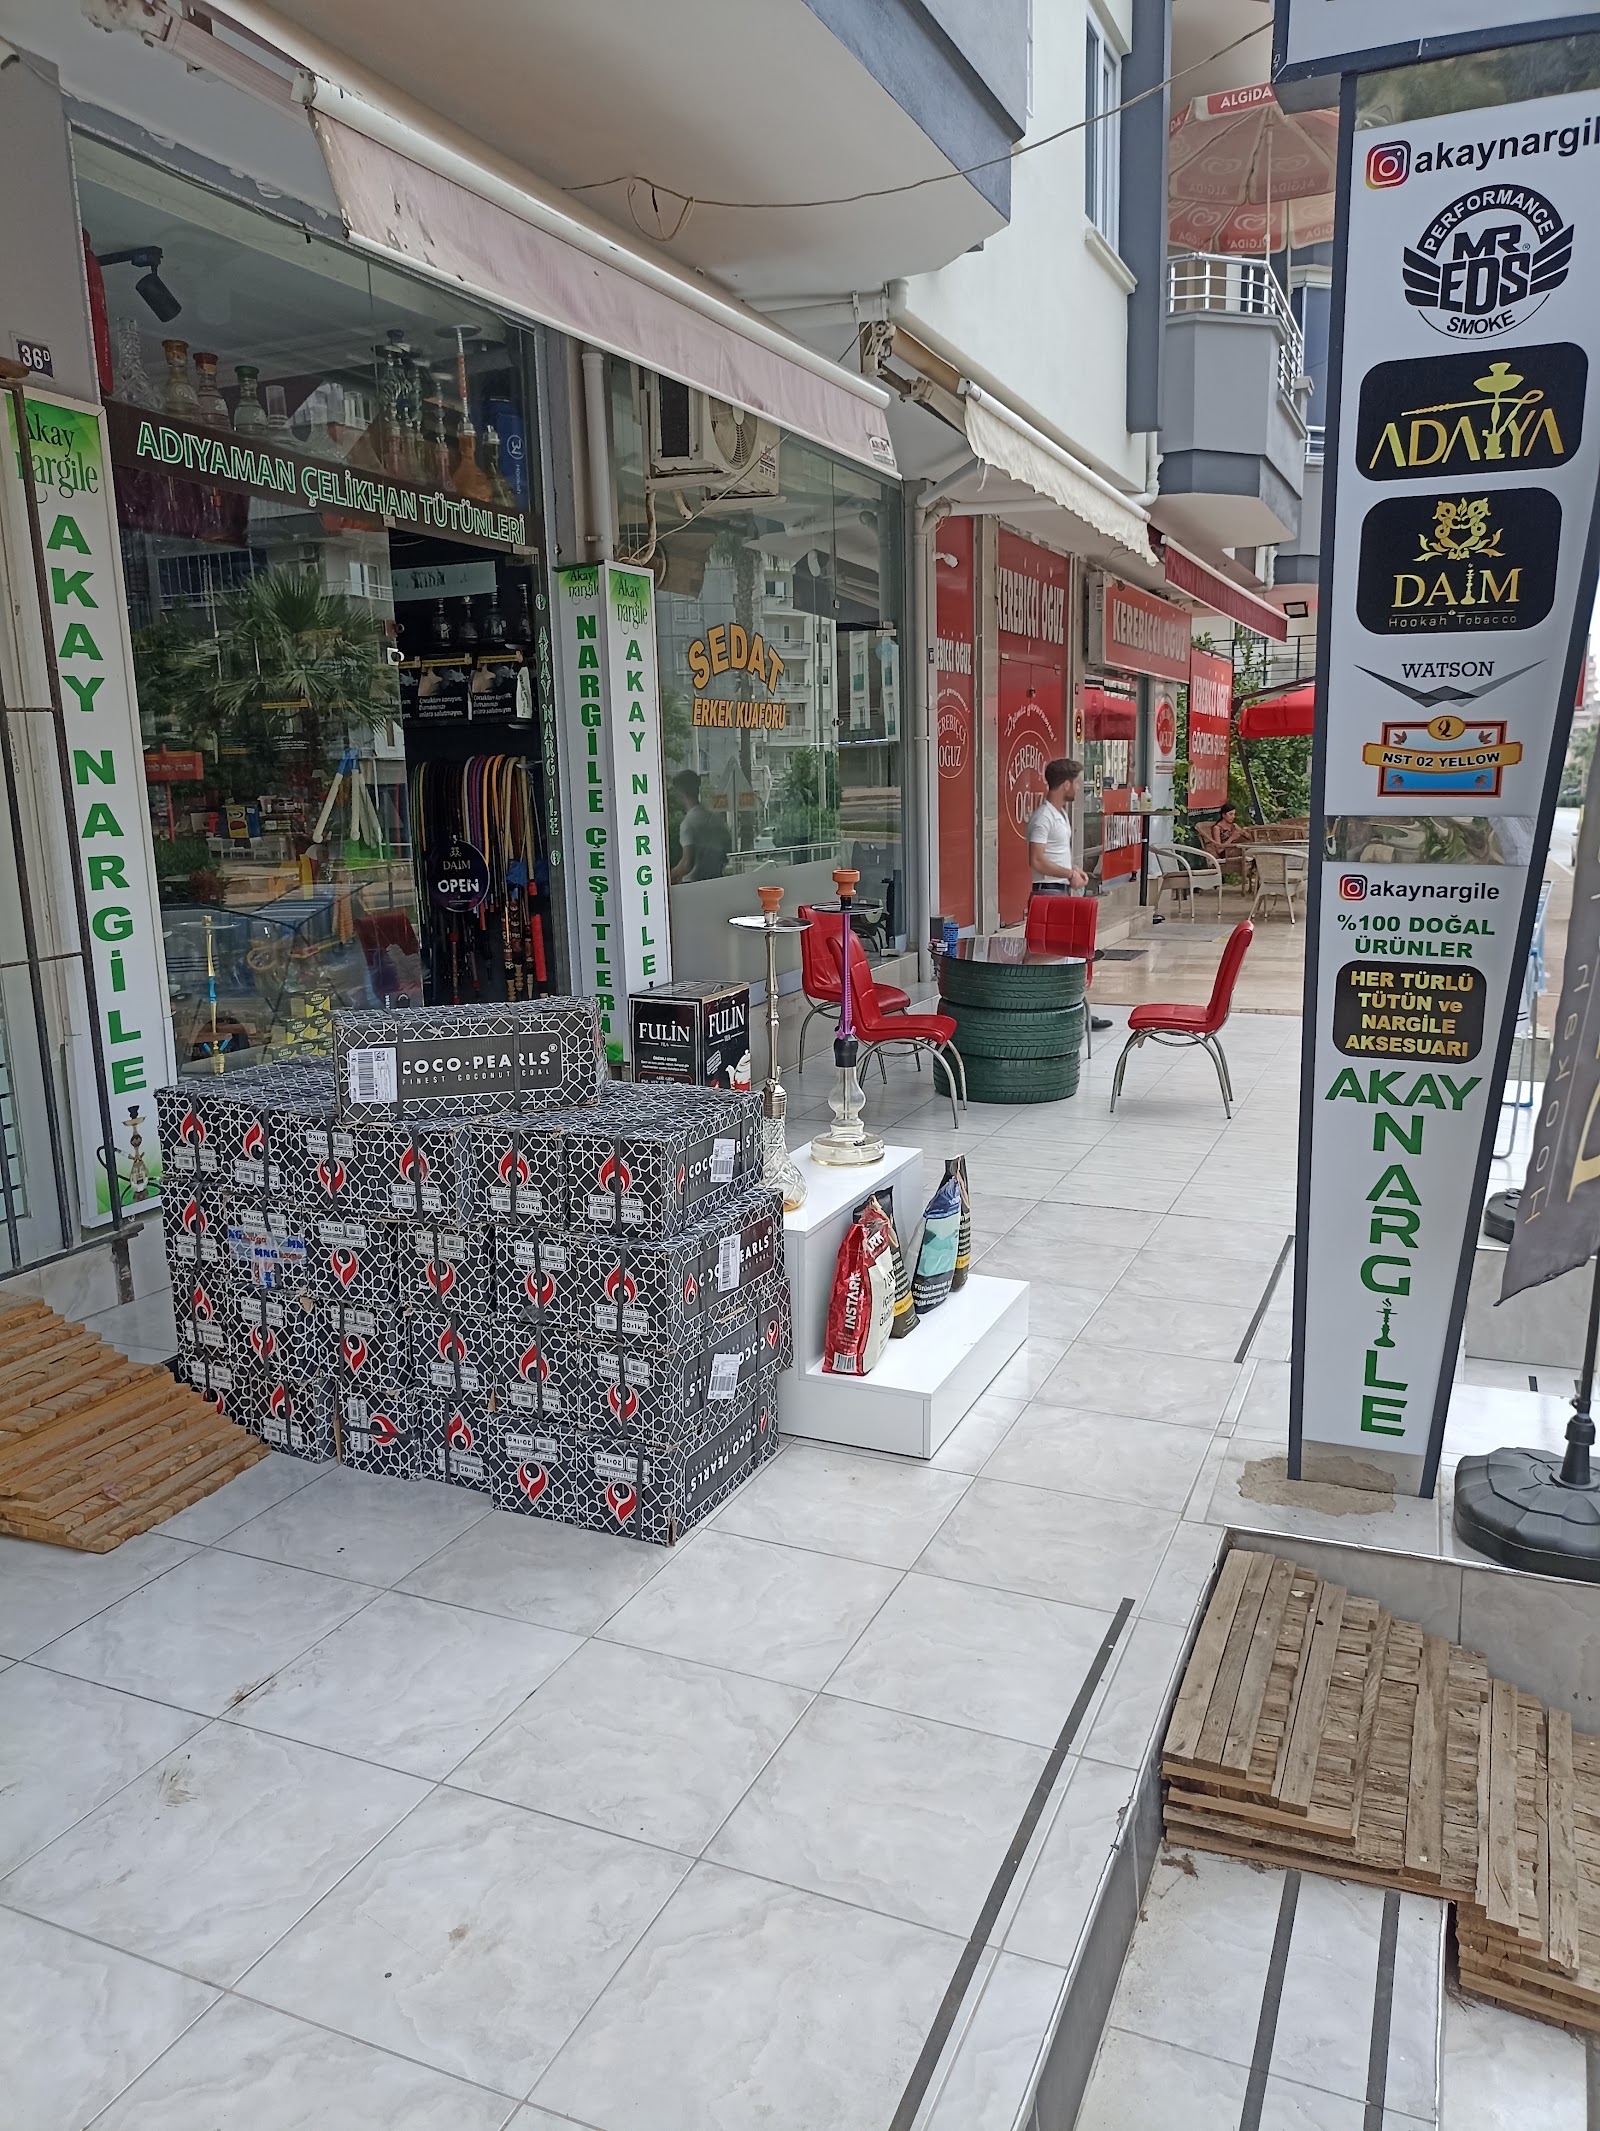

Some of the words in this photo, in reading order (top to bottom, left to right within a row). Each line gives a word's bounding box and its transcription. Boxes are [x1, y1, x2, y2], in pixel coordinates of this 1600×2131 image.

[1414, 116, 1600, 174] akaynargil
[1423, 189, 1555, 251] PERFORMANCE
[1440, 252, 1531, 315] EDS
[1446, 309, 1516, 335] SMOKE
[136, 421, 297, 494] ADIYAMAN
[302, 466, 417, 521] ÇELİKHAN
[419, 491, 527, 545] TÜTÜNLERİ
[570, 569, 594, 587] Akay
[618, 579, 644, 601] Akay
[46, 514, 105, 712] AKAY
[617, 601, 648, 635] nargile
[1388, 615, 1448, 628] Hookah
[1456, 612, 1517, 626] Tobacco
[688, 622, 785, 696] SEDAT
[1402, 660, 1495, 679] WATSON
[626, 639, 645, 753] AKAY
[576, 615, 604, 813] NARGİLE
[693, 697, 734, 728] ERKEK
[939, 741, 961, 767] OĞUZ
[1382, 752, 1412, 766] NST
[1415, 755, 1434, 767] 02
[1439, 752, 1500, 767] YELLOW
[438, 879, 479, 893] OPEN
[632, 774, 656, 976] NARGİLE
[1369, 880, 1500, 903] akaynargile
[73, 749, 148, 1094] NARGİLE
[1337, 914, 1401, 934] %100
[1409, 913, 1496, 937] DOĞAL
[1355, 936, 1473, 959] ÜRÜNLER
[1351, 970, 1395, 988] HER
[1400, 971, 1474, 992] TÜRLÜ
[1358, 991, 1433, 1013] TÜTÜN
[1437, 999, 1463, 1013] ve
[1361, 1011, 1456, 1035] NARGİLE
[1345, 1036, 1469, 1057] AKSESUARI
[458, 1070, 511, 1081] COCONUT
[1325, 1066, 1483, 1110] AKAY
[845, 1270, 862, 1330] INSTARK
